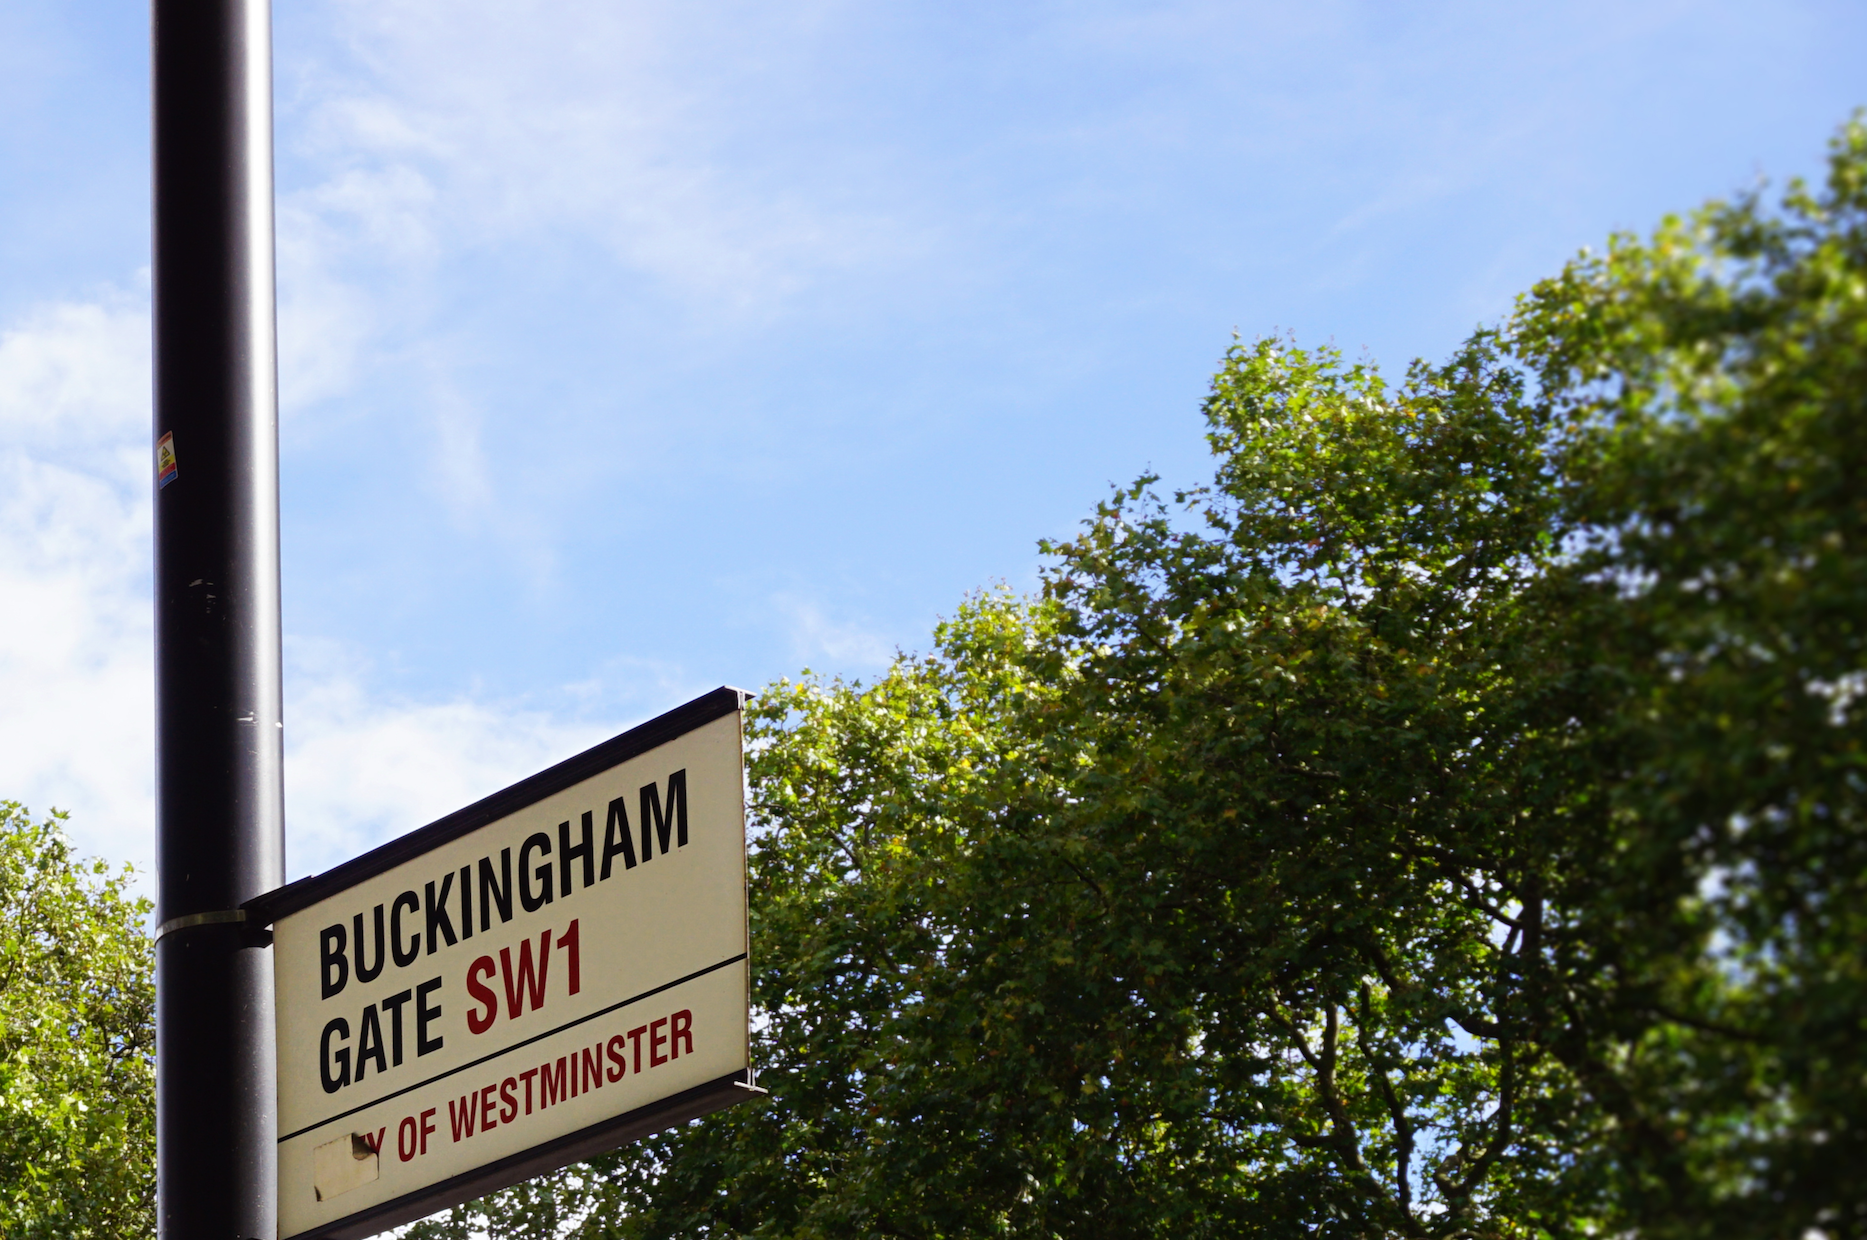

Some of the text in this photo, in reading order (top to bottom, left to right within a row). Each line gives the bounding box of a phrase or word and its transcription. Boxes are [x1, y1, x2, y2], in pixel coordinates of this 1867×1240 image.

[320, 767, 689, 1001] BUCKINGHAM
[320, 918, 581, 1094] GATE SW1
[397, 1008, 695, 1162] OF WESTMINSTER
